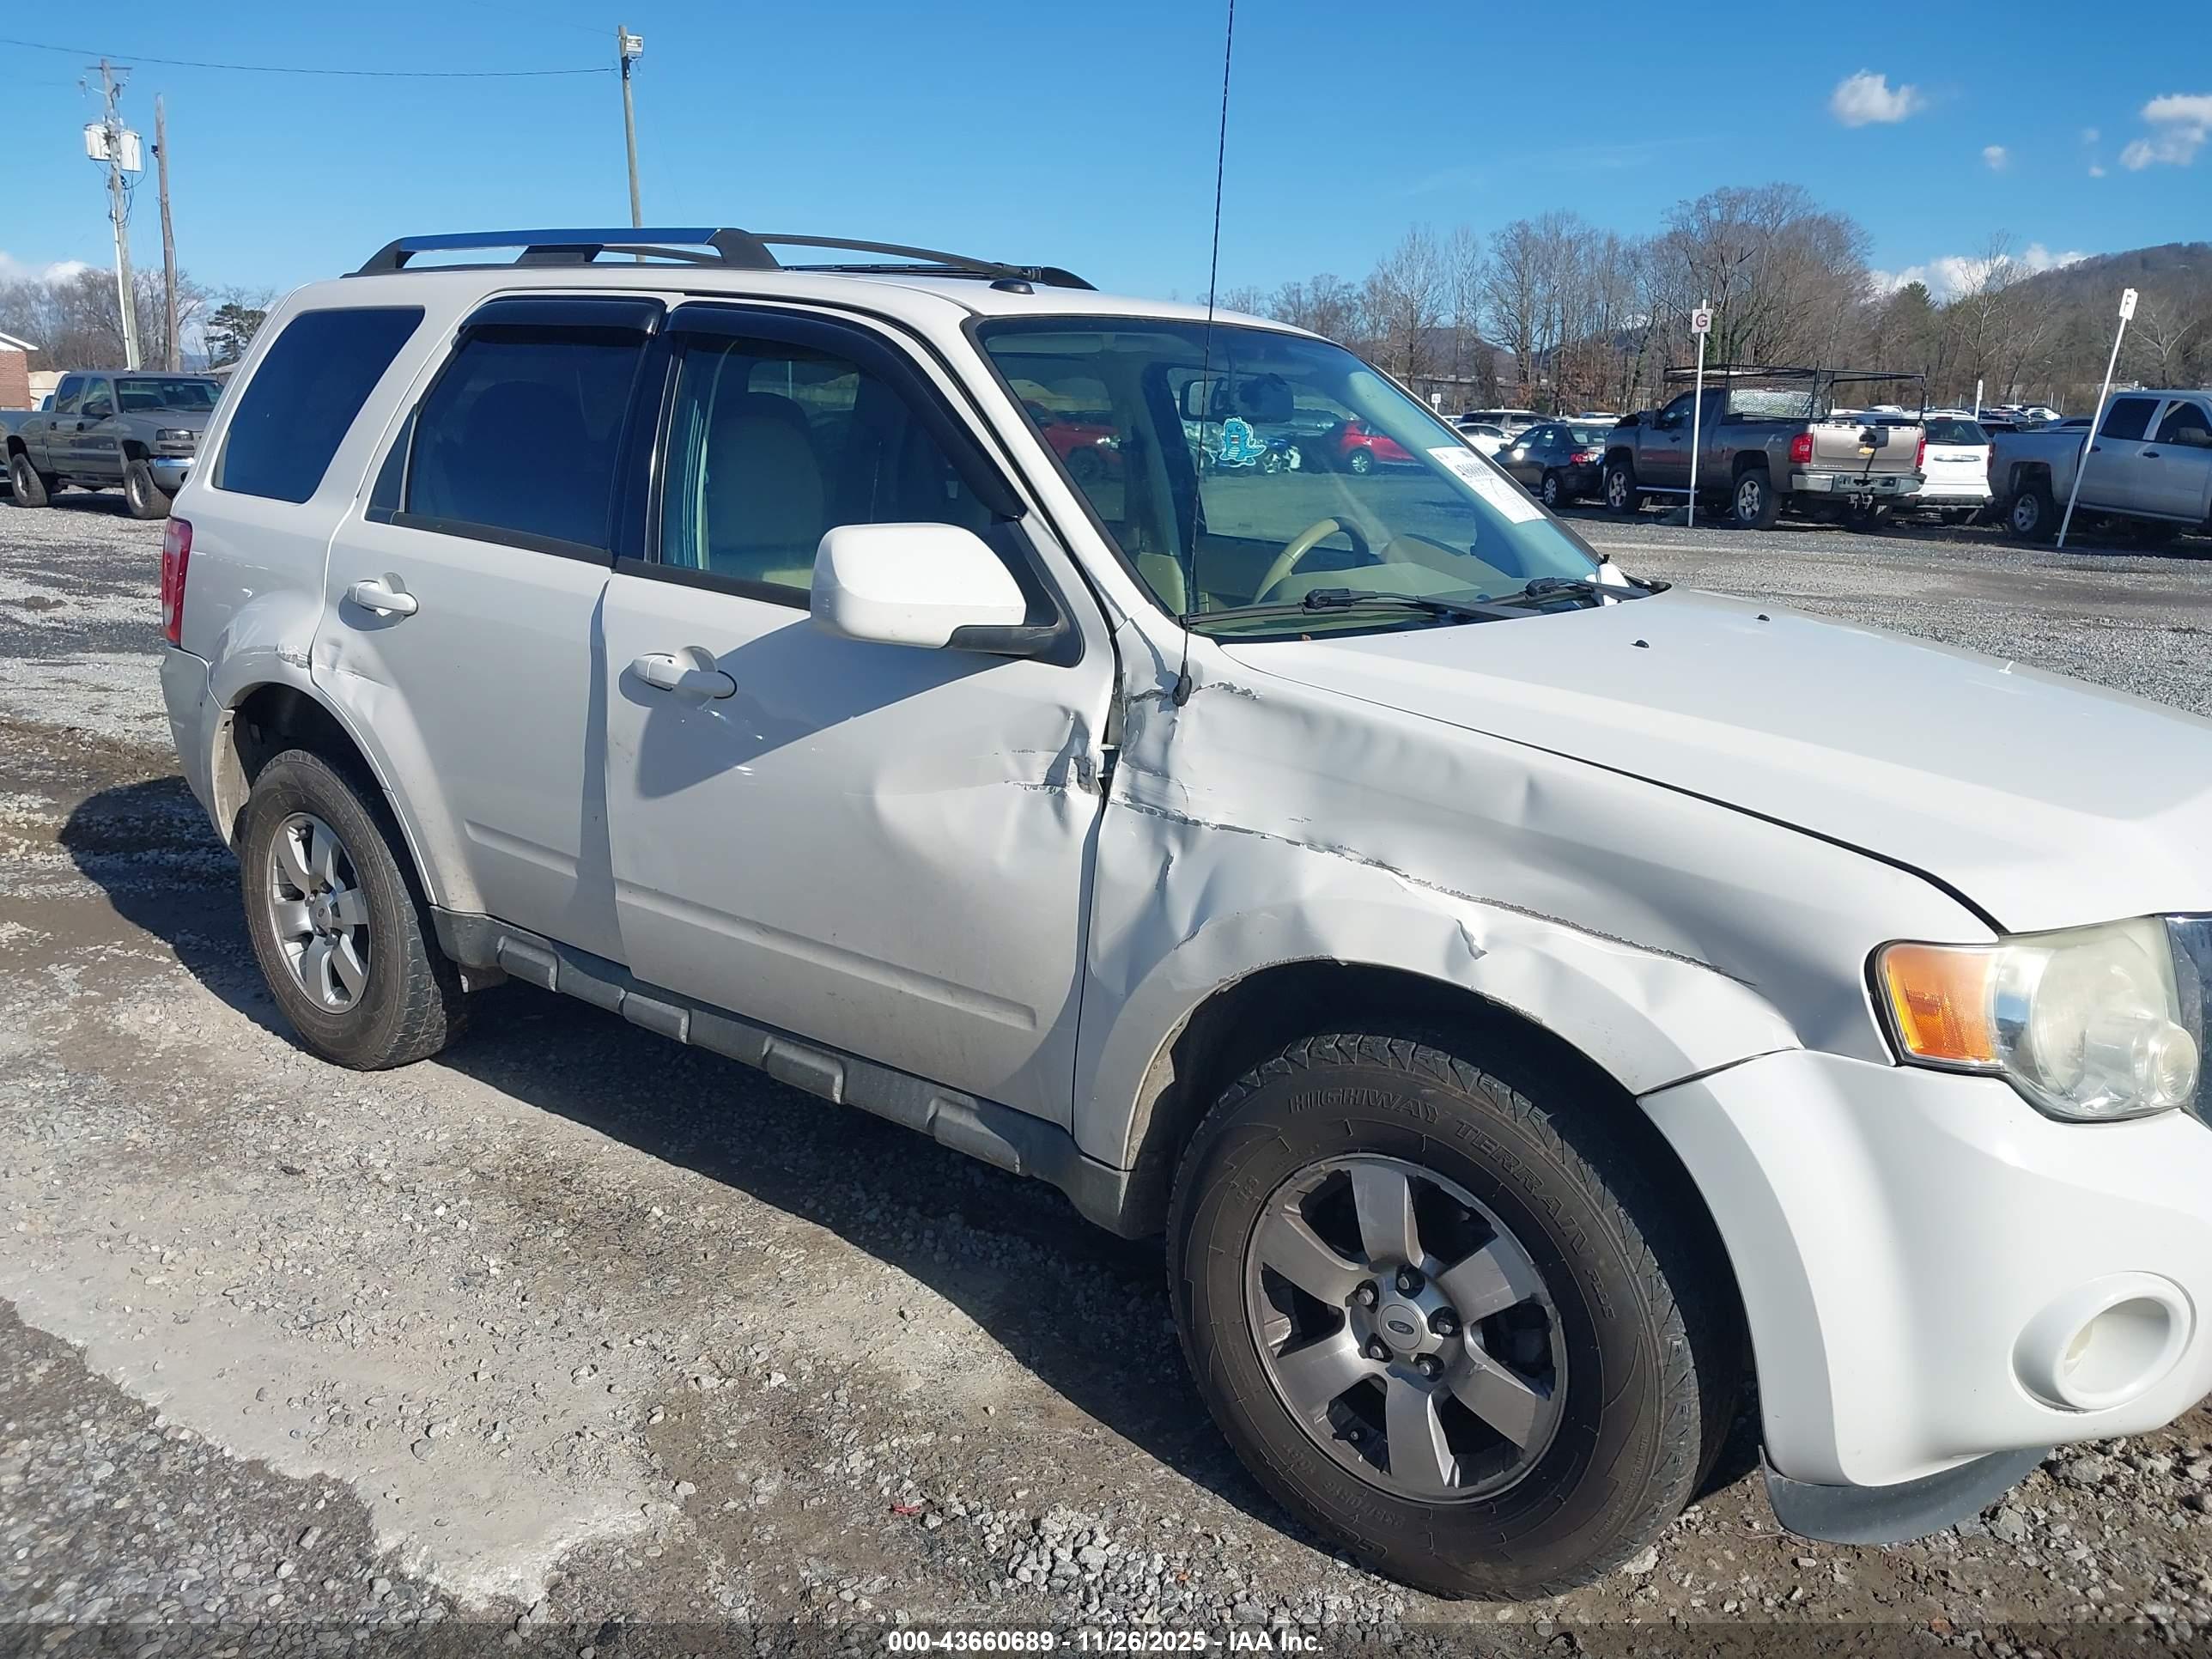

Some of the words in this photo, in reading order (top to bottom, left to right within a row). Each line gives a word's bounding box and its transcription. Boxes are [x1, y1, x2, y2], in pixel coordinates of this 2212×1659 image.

[1695, 313, 1708, 328] G
[1288, 1086, 1439, 1125] HIGHWAY
[1455, 1118, 1588, 1256] TERRAIN
